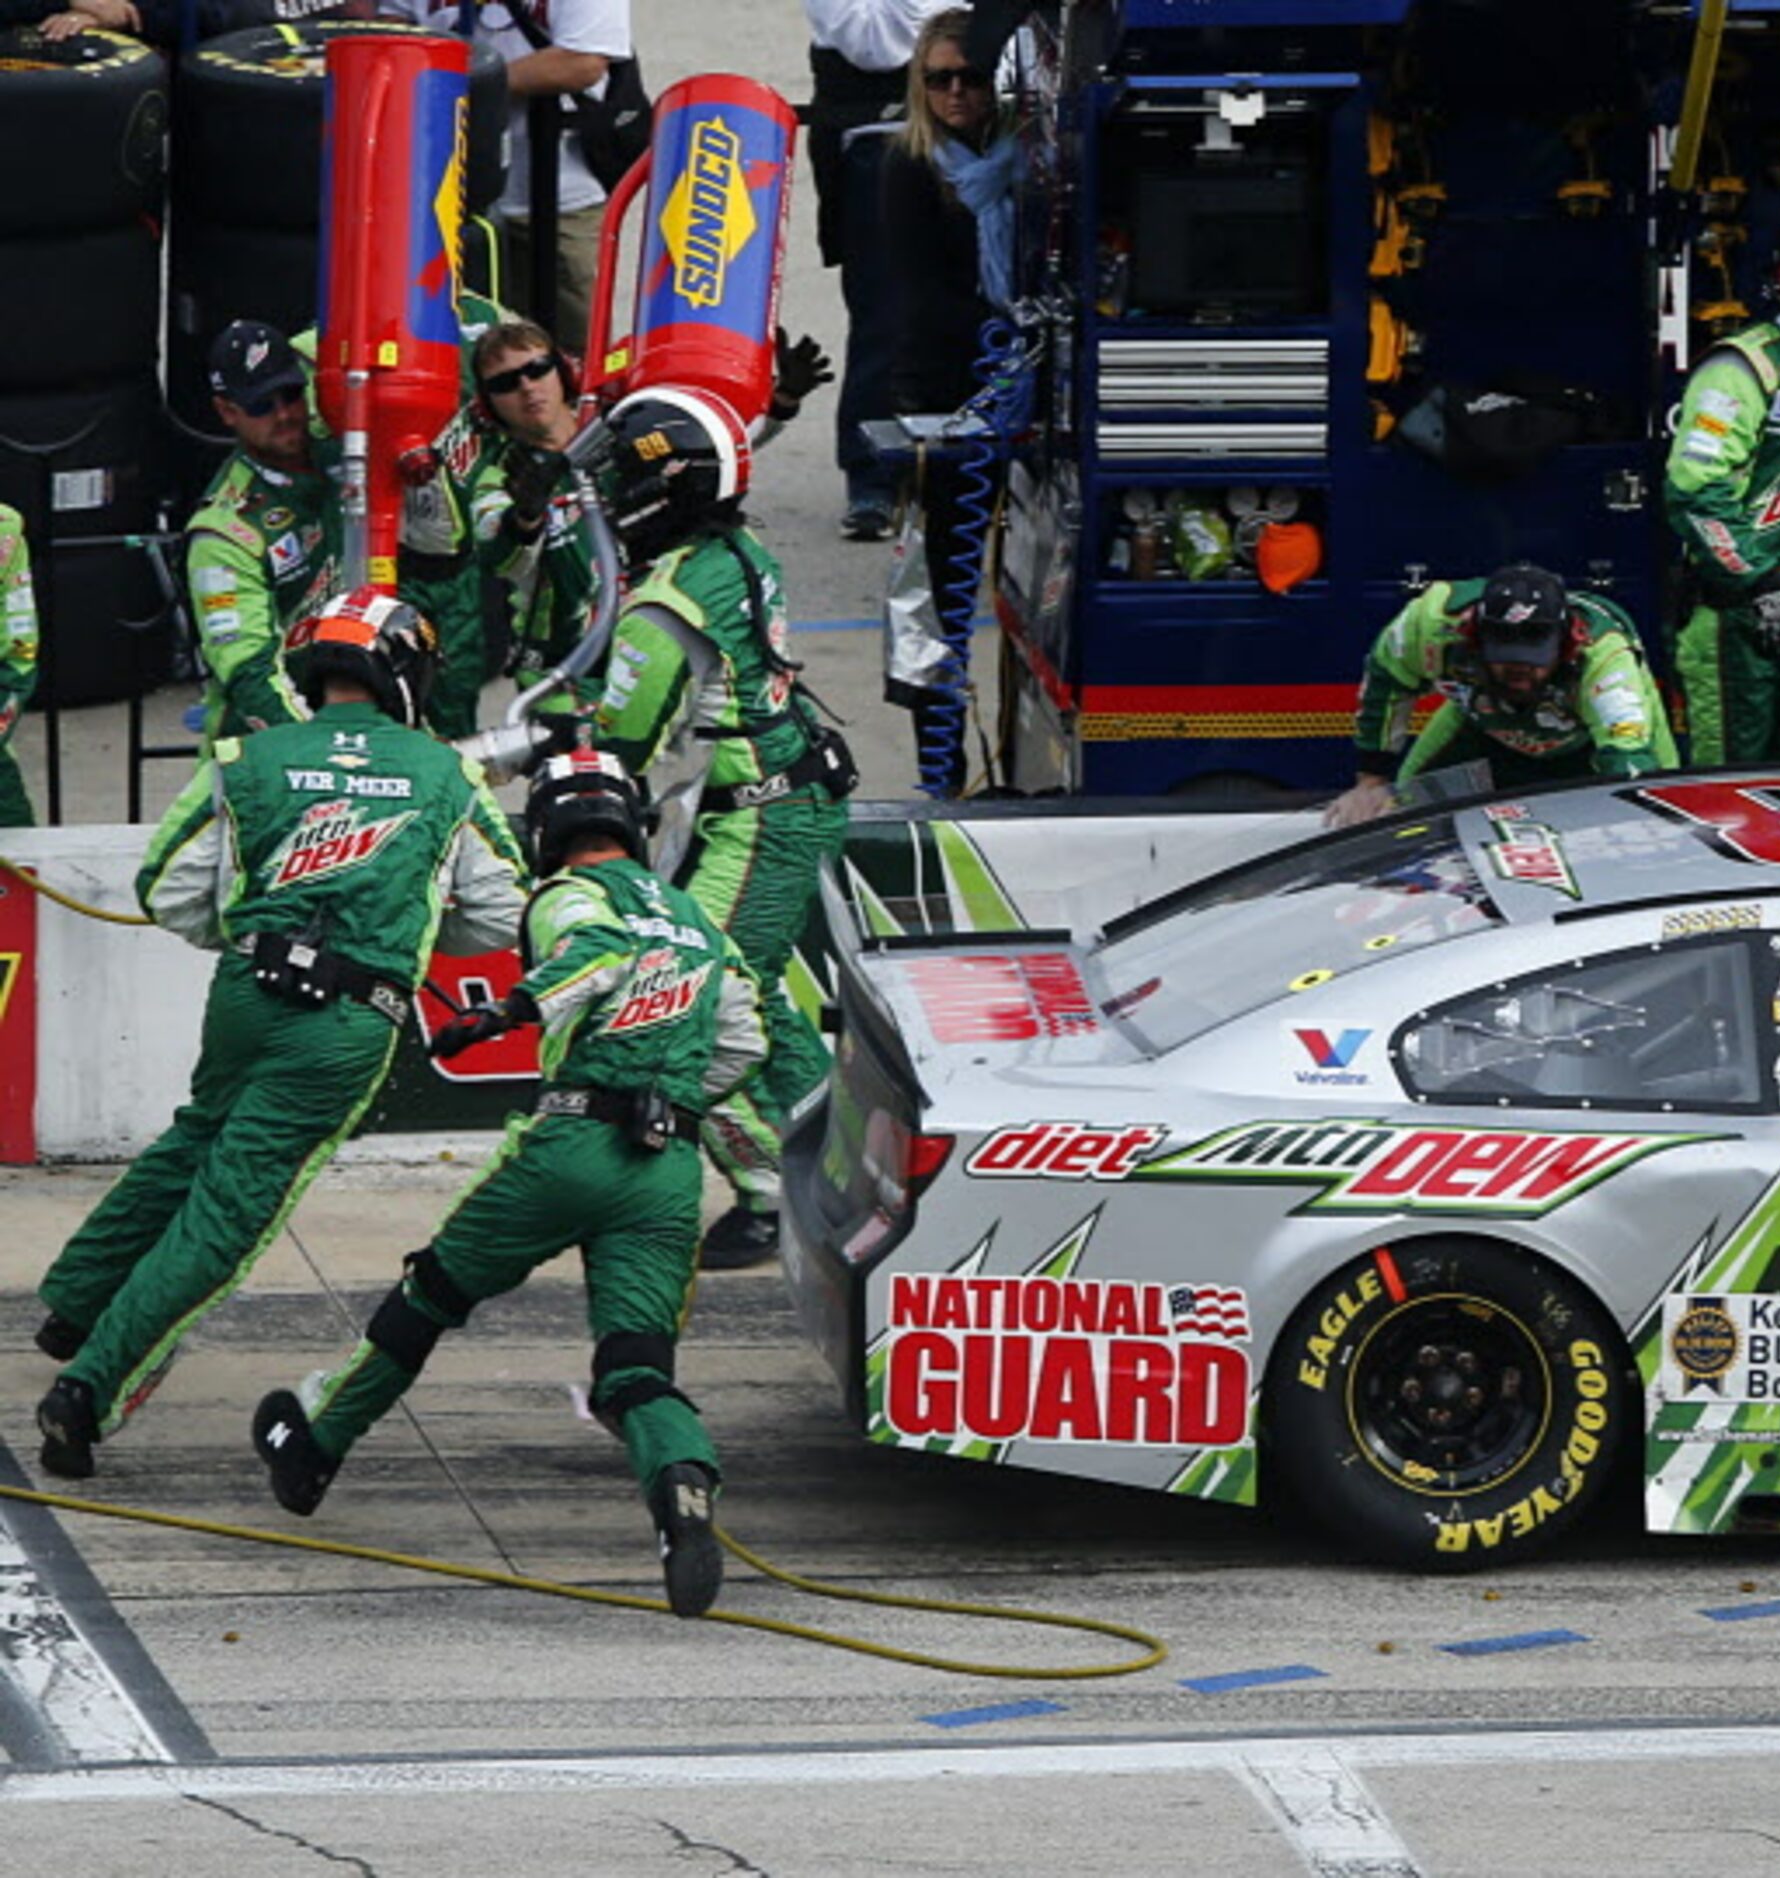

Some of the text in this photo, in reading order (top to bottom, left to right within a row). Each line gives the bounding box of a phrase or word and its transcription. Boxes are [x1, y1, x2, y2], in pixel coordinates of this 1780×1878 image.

[681, 126, 732, 305] SUNOCO
[286, 769, 411, 798] VER MEER
[1293, 1071, 1371, 1086] Valvoline
[974, 1123, 1645, 1198] diet Mtn DEW
[891, 1276, 1170, 1337] NATIONAL
[1298, 1267, 1383, 1391] EAGLE
[888, 1331, 1250, 1446] GUARD
[1434, 1338, 1610, 1552] GOODYEAR
